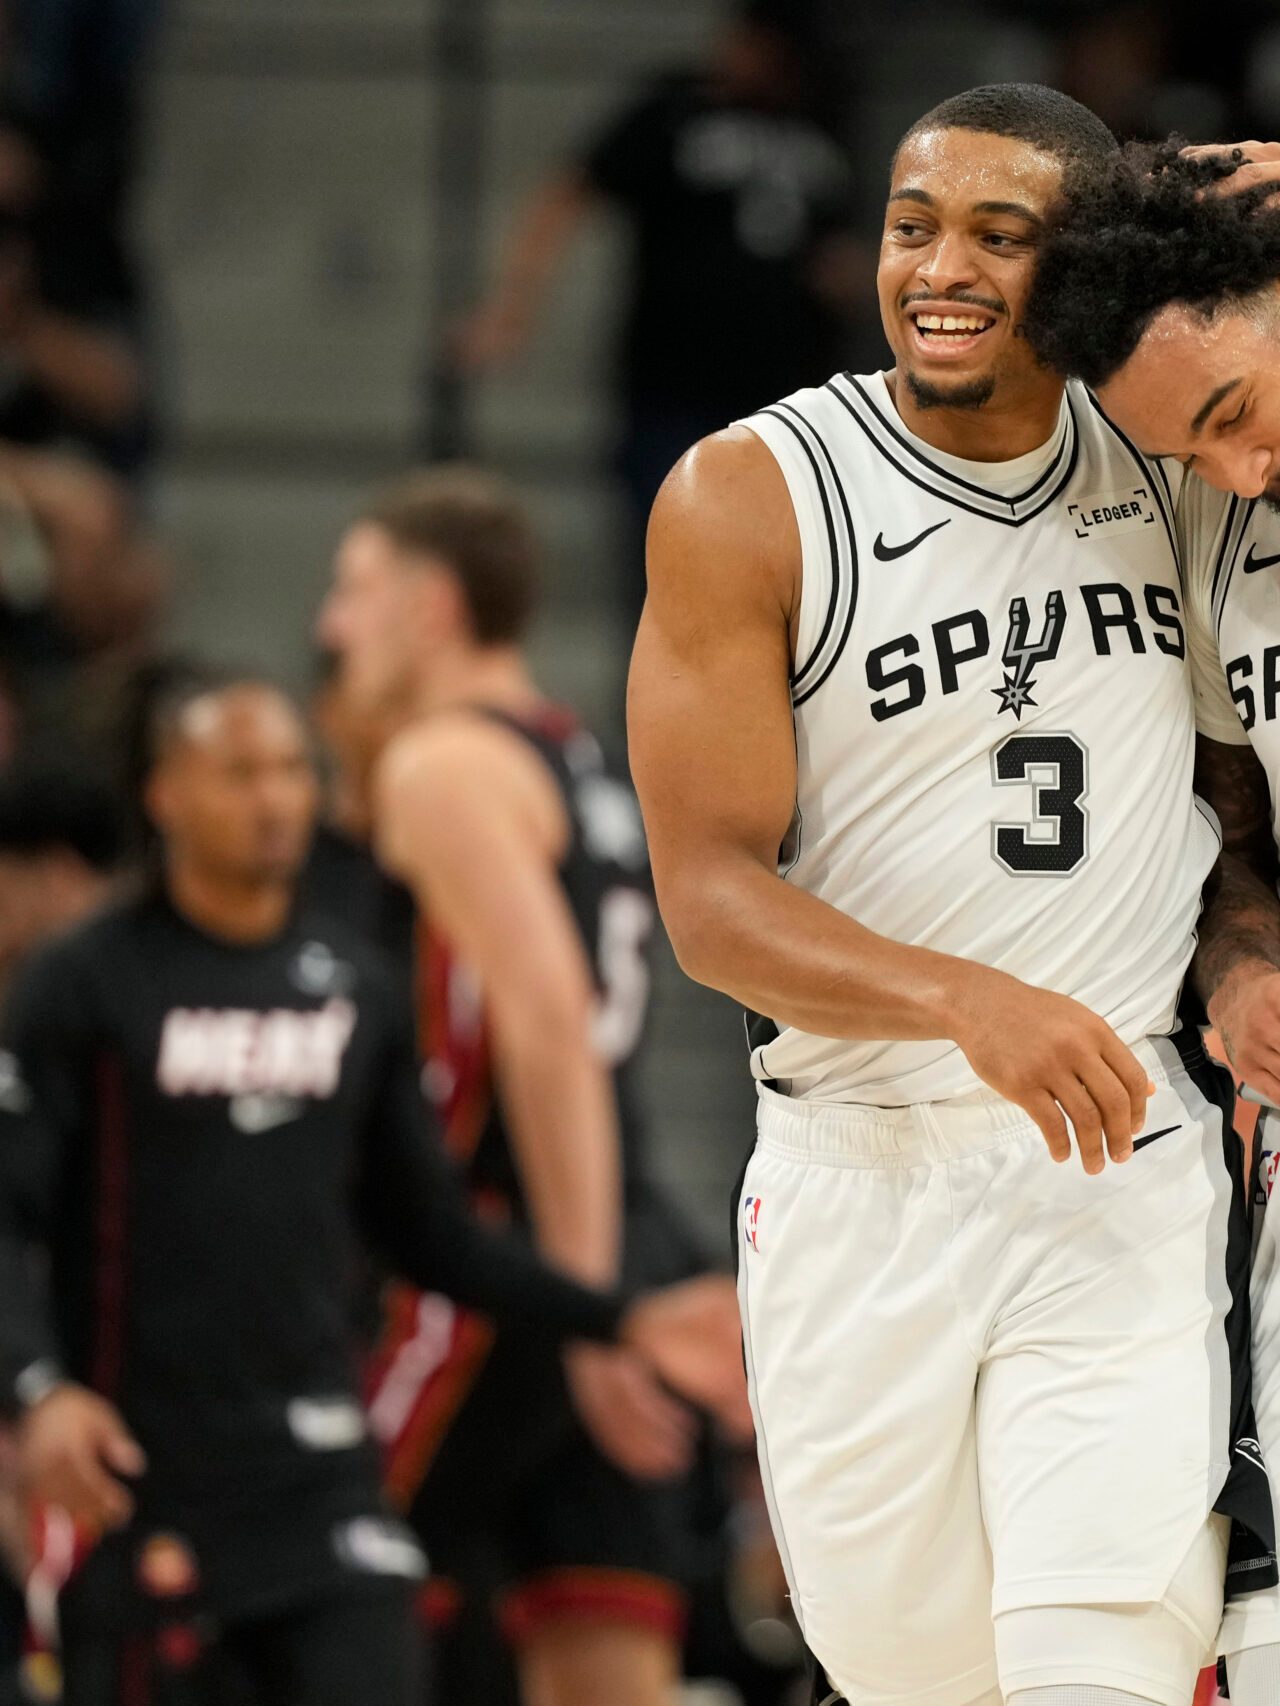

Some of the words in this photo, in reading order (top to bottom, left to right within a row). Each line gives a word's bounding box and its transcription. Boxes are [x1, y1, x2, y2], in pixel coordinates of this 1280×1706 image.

[1079, 500, 1143, 527] LEDGER
[864, 582, 1186, 723] SPURS
[988, 729, 1091, 879] 3
